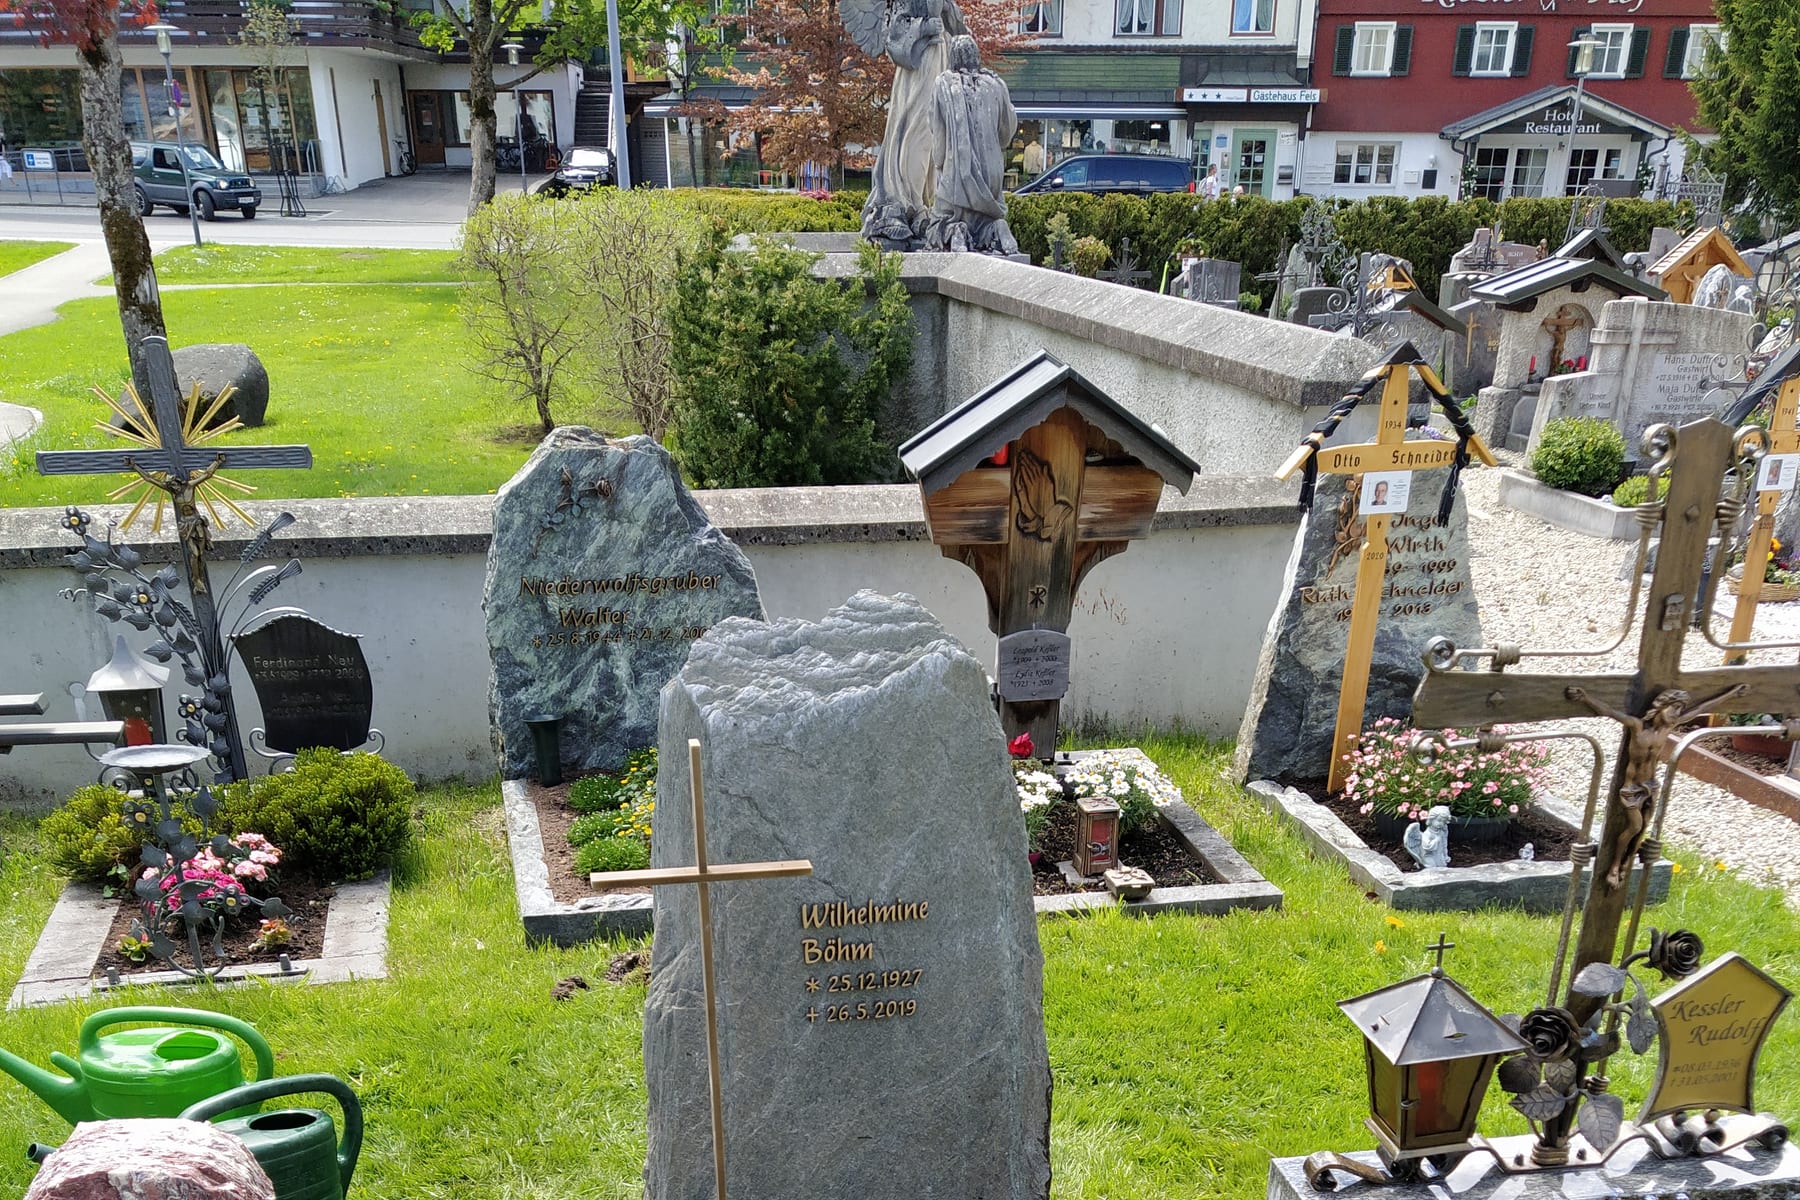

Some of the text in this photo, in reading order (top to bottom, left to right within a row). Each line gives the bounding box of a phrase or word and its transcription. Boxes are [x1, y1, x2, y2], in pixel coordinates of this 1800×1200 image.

[1253, 90, 1317, 102] Gästehaus Fels
[1664, 354, 1686, 364] Hans
[1384, 420, 1402, 430] 1934
[1333, 449, 1456, 469] Otto Schneider
[1366, 552, 1385, 561] 2020
[519, 570, 722, 598] Niederwolfsgruber
[1300, 579, 1465, 604] Ruth hneider
[560, 606, 630, 628] Walter
[327, 652, 355, 666] Neu
[801, 898, 930, 930] Wilhelmine
[801, 937, 874, 965] Böhm
[1670, 993, 1746, 1022] Kessler
[1688, 1016, 1769, 1047] Rudolf
